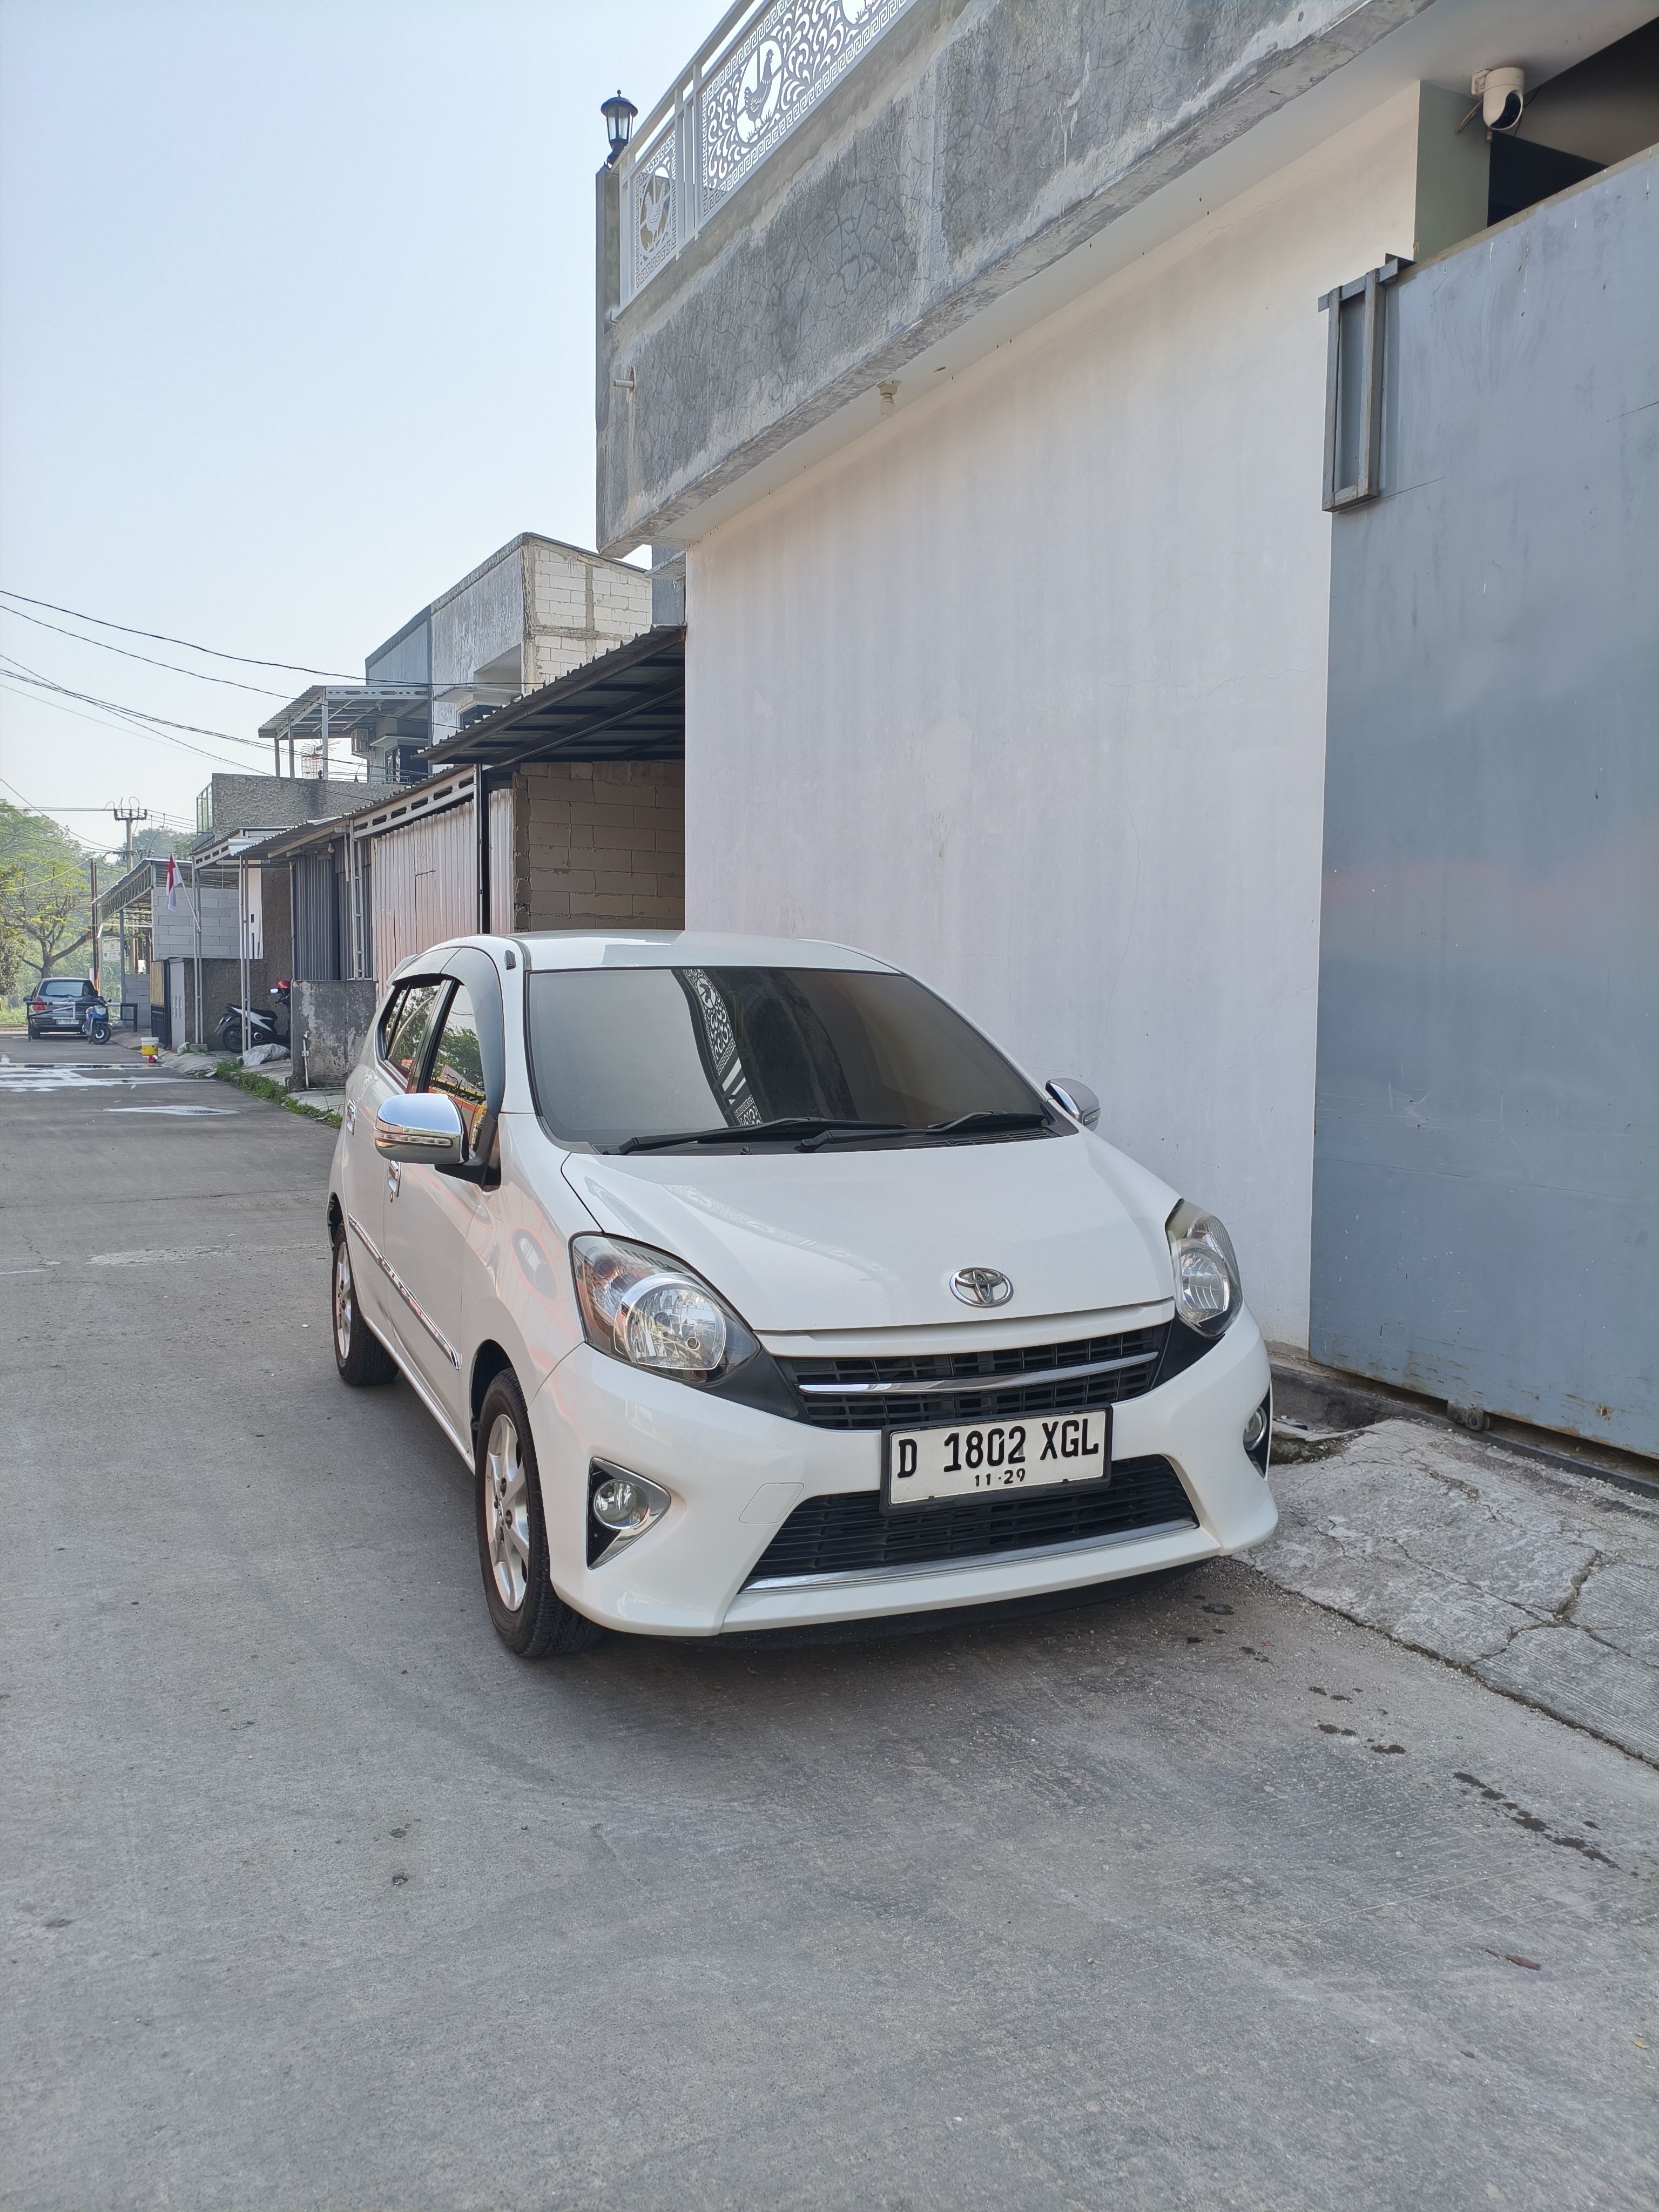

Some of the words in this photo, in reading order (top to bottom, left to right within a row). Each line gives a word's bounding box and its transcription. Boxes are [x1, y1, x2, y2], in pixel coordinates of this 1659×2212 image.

[897, 1438, 918, 1479] D
[943, 1426, 1026, 1473] 1802
[1040, 1418, 1099, 1460] XGL
